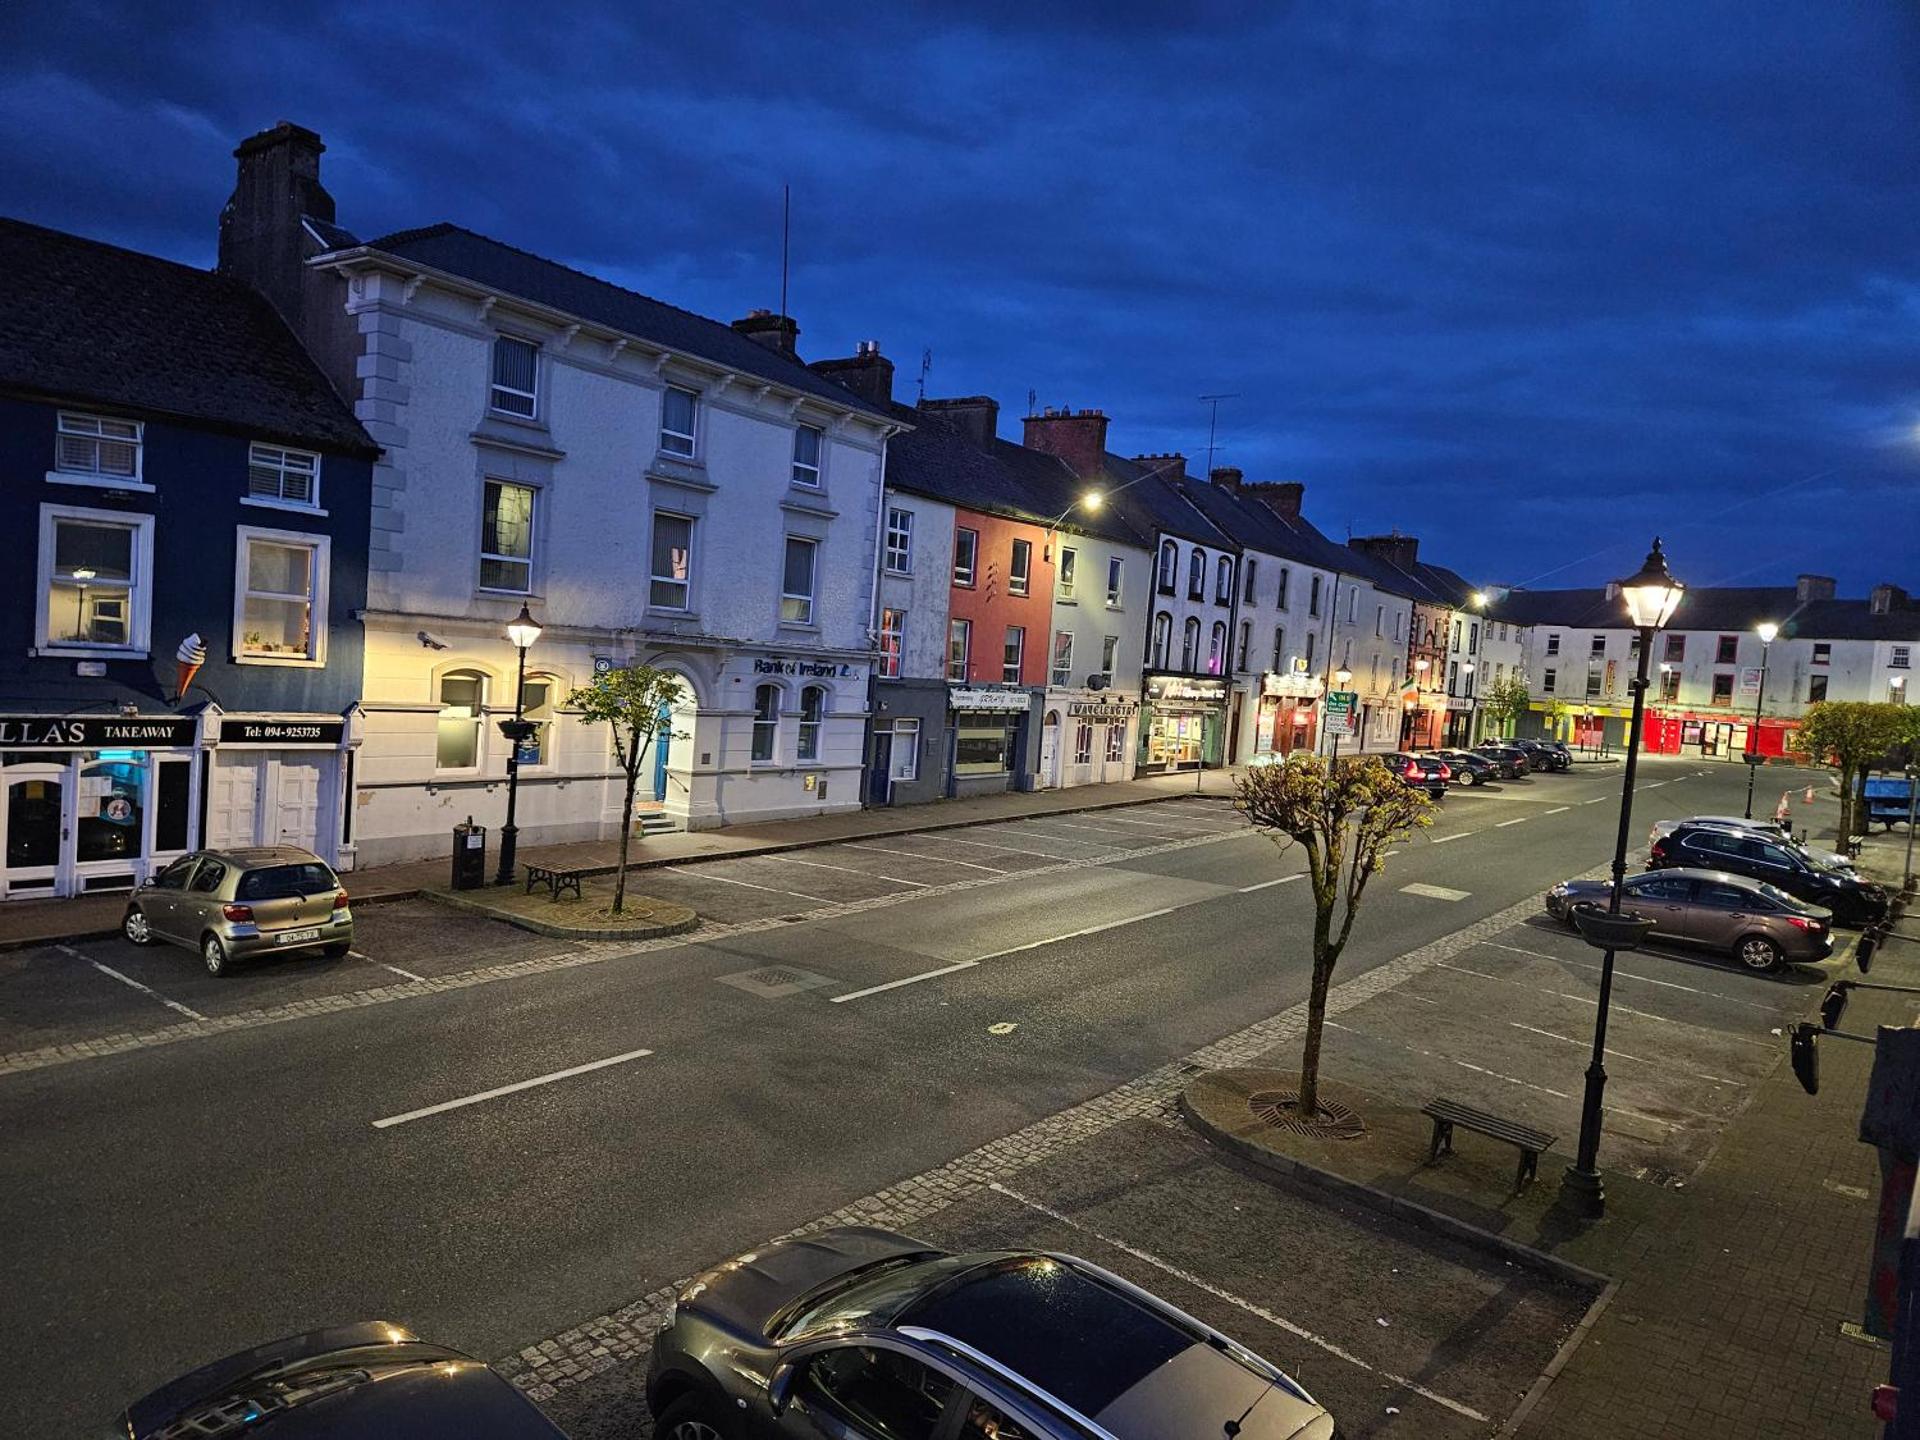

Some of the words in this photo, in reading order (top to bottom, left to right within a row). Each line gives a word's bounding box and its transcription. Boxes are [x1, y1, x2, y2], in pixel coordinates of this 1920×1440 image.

[754, 659, 784, 673] Bank
[785, 661, 796, 675] of
[799, 662, 836, 677] Ireland
[104, 726, 175, 738] TAKEAWAY
[244, 726, 262, 737] Tel:
[264, 726, 321, 738] 094-9253735
